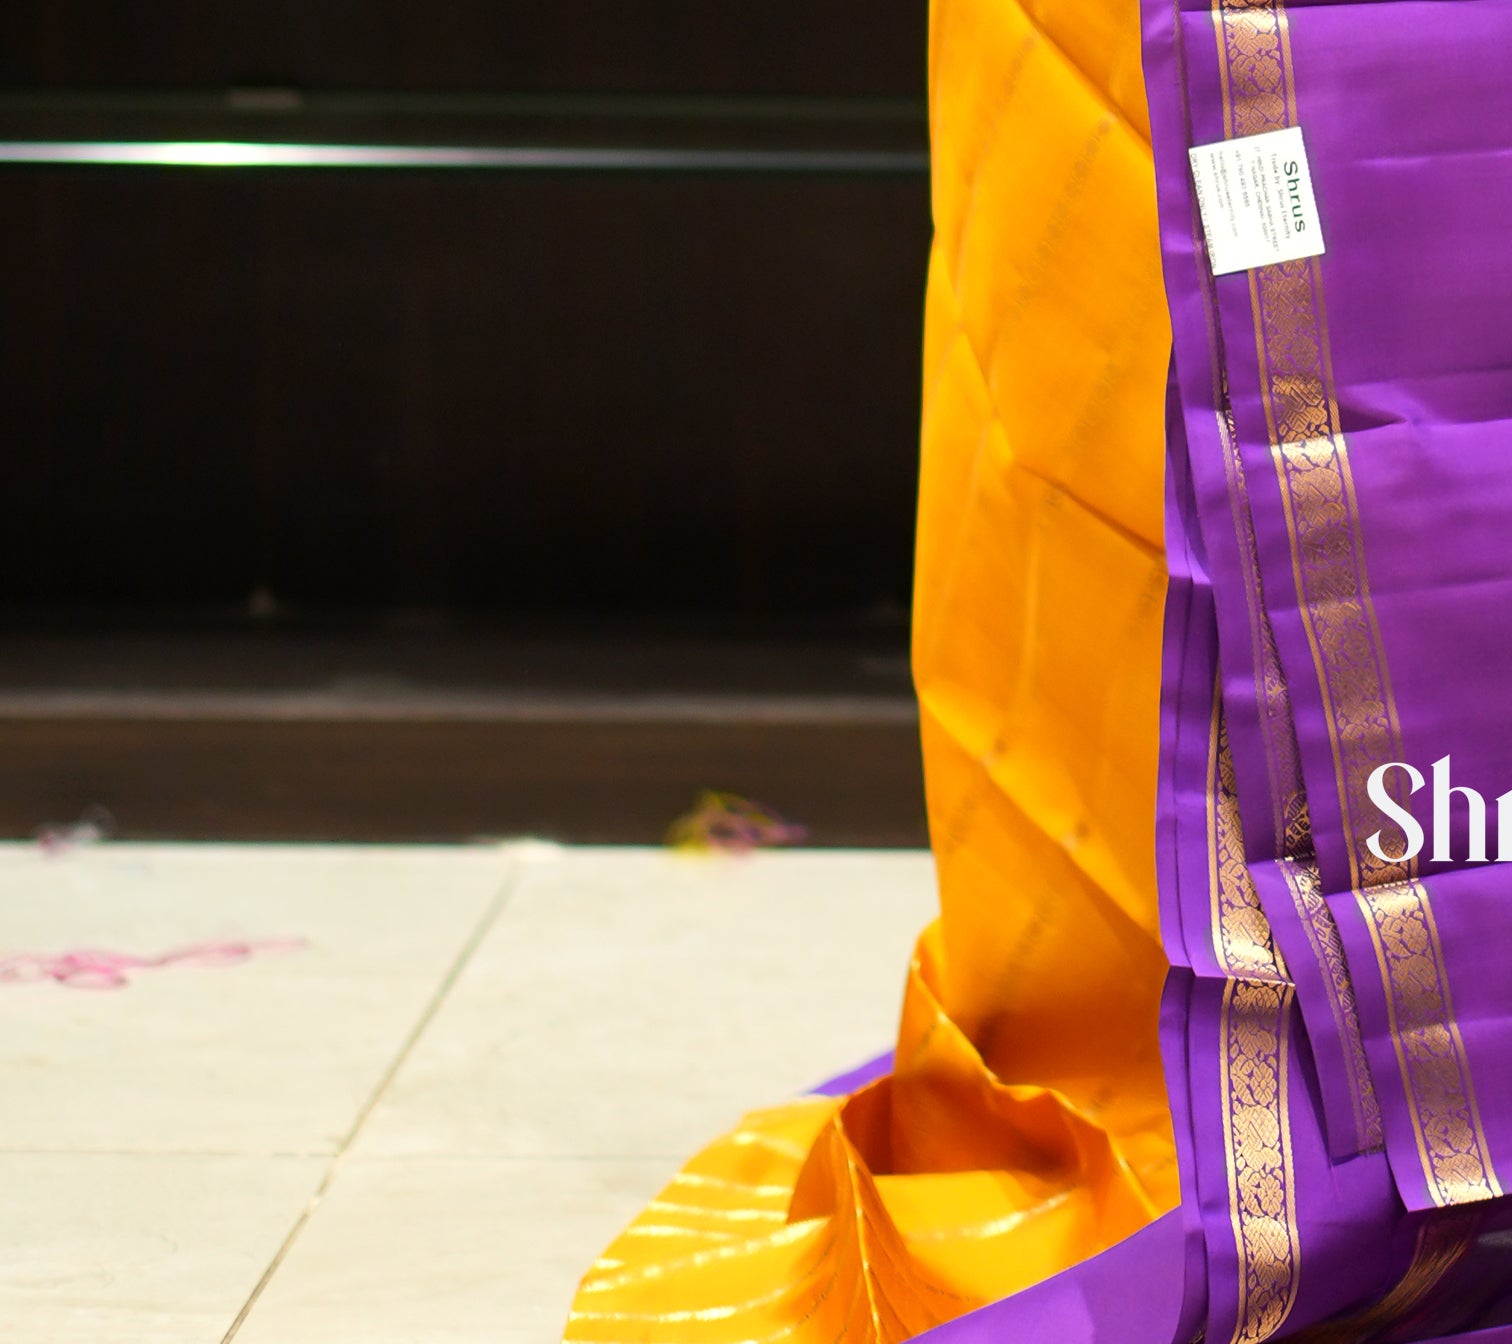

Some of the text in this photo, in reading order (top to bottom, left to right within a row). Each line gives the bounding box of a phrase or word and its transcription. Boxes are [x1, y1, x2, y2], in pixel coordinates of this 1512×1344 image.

[1270, 152, 1280, 173] Trade
[1276, 187, 1286, 208] Shrus
[1283, 160, 1306, 233] Shrus
[1279, 210, 1292, 240] Eternity
